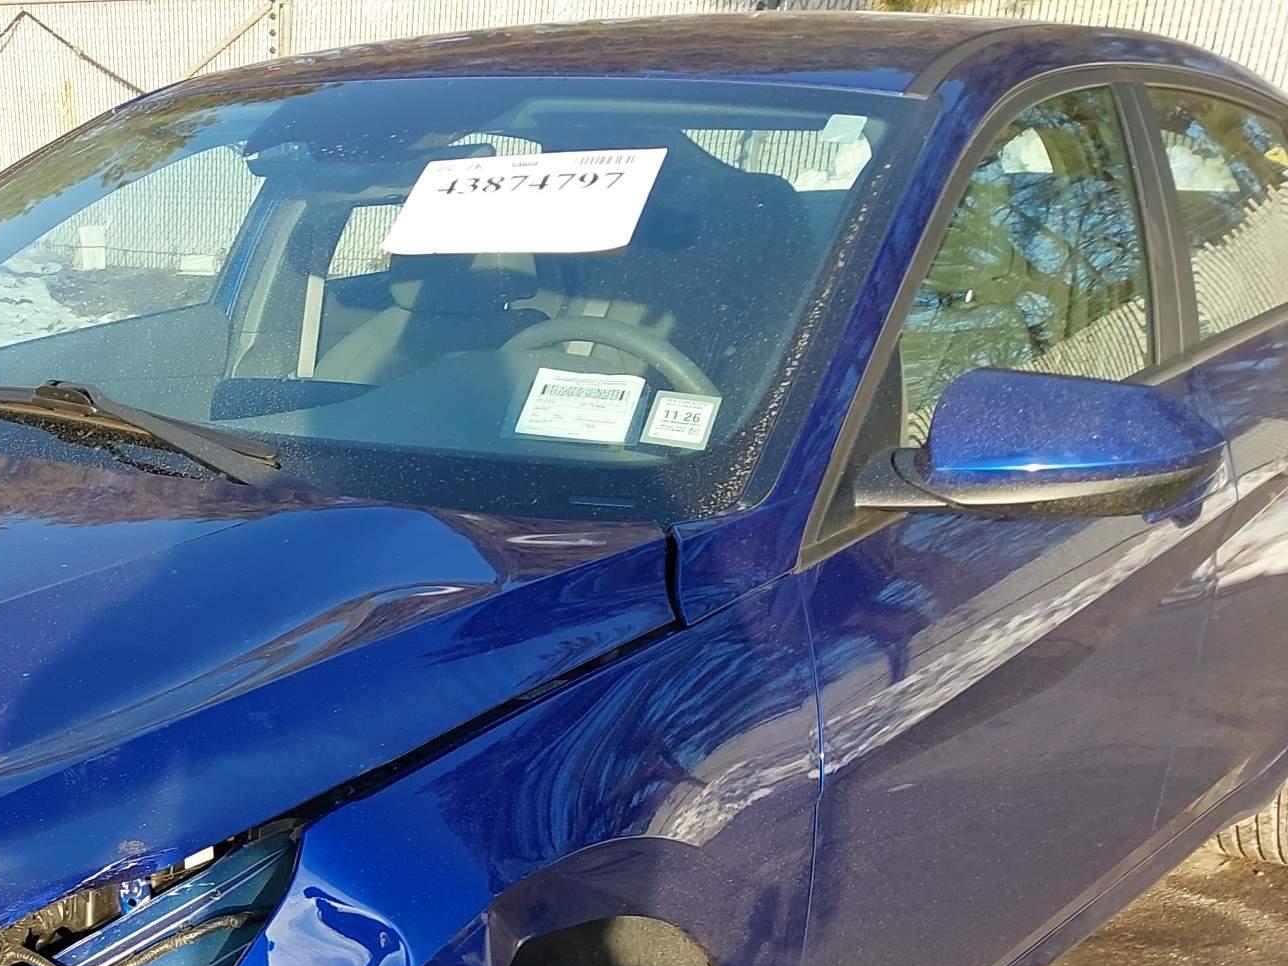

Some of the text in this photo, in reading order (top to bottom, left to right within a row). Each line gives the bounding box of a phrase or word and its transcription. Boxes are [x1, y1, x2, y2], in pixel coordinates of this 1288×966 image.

[437, 171, 625, 195] 43874797
[664, 409, 702, 424] 11 26
